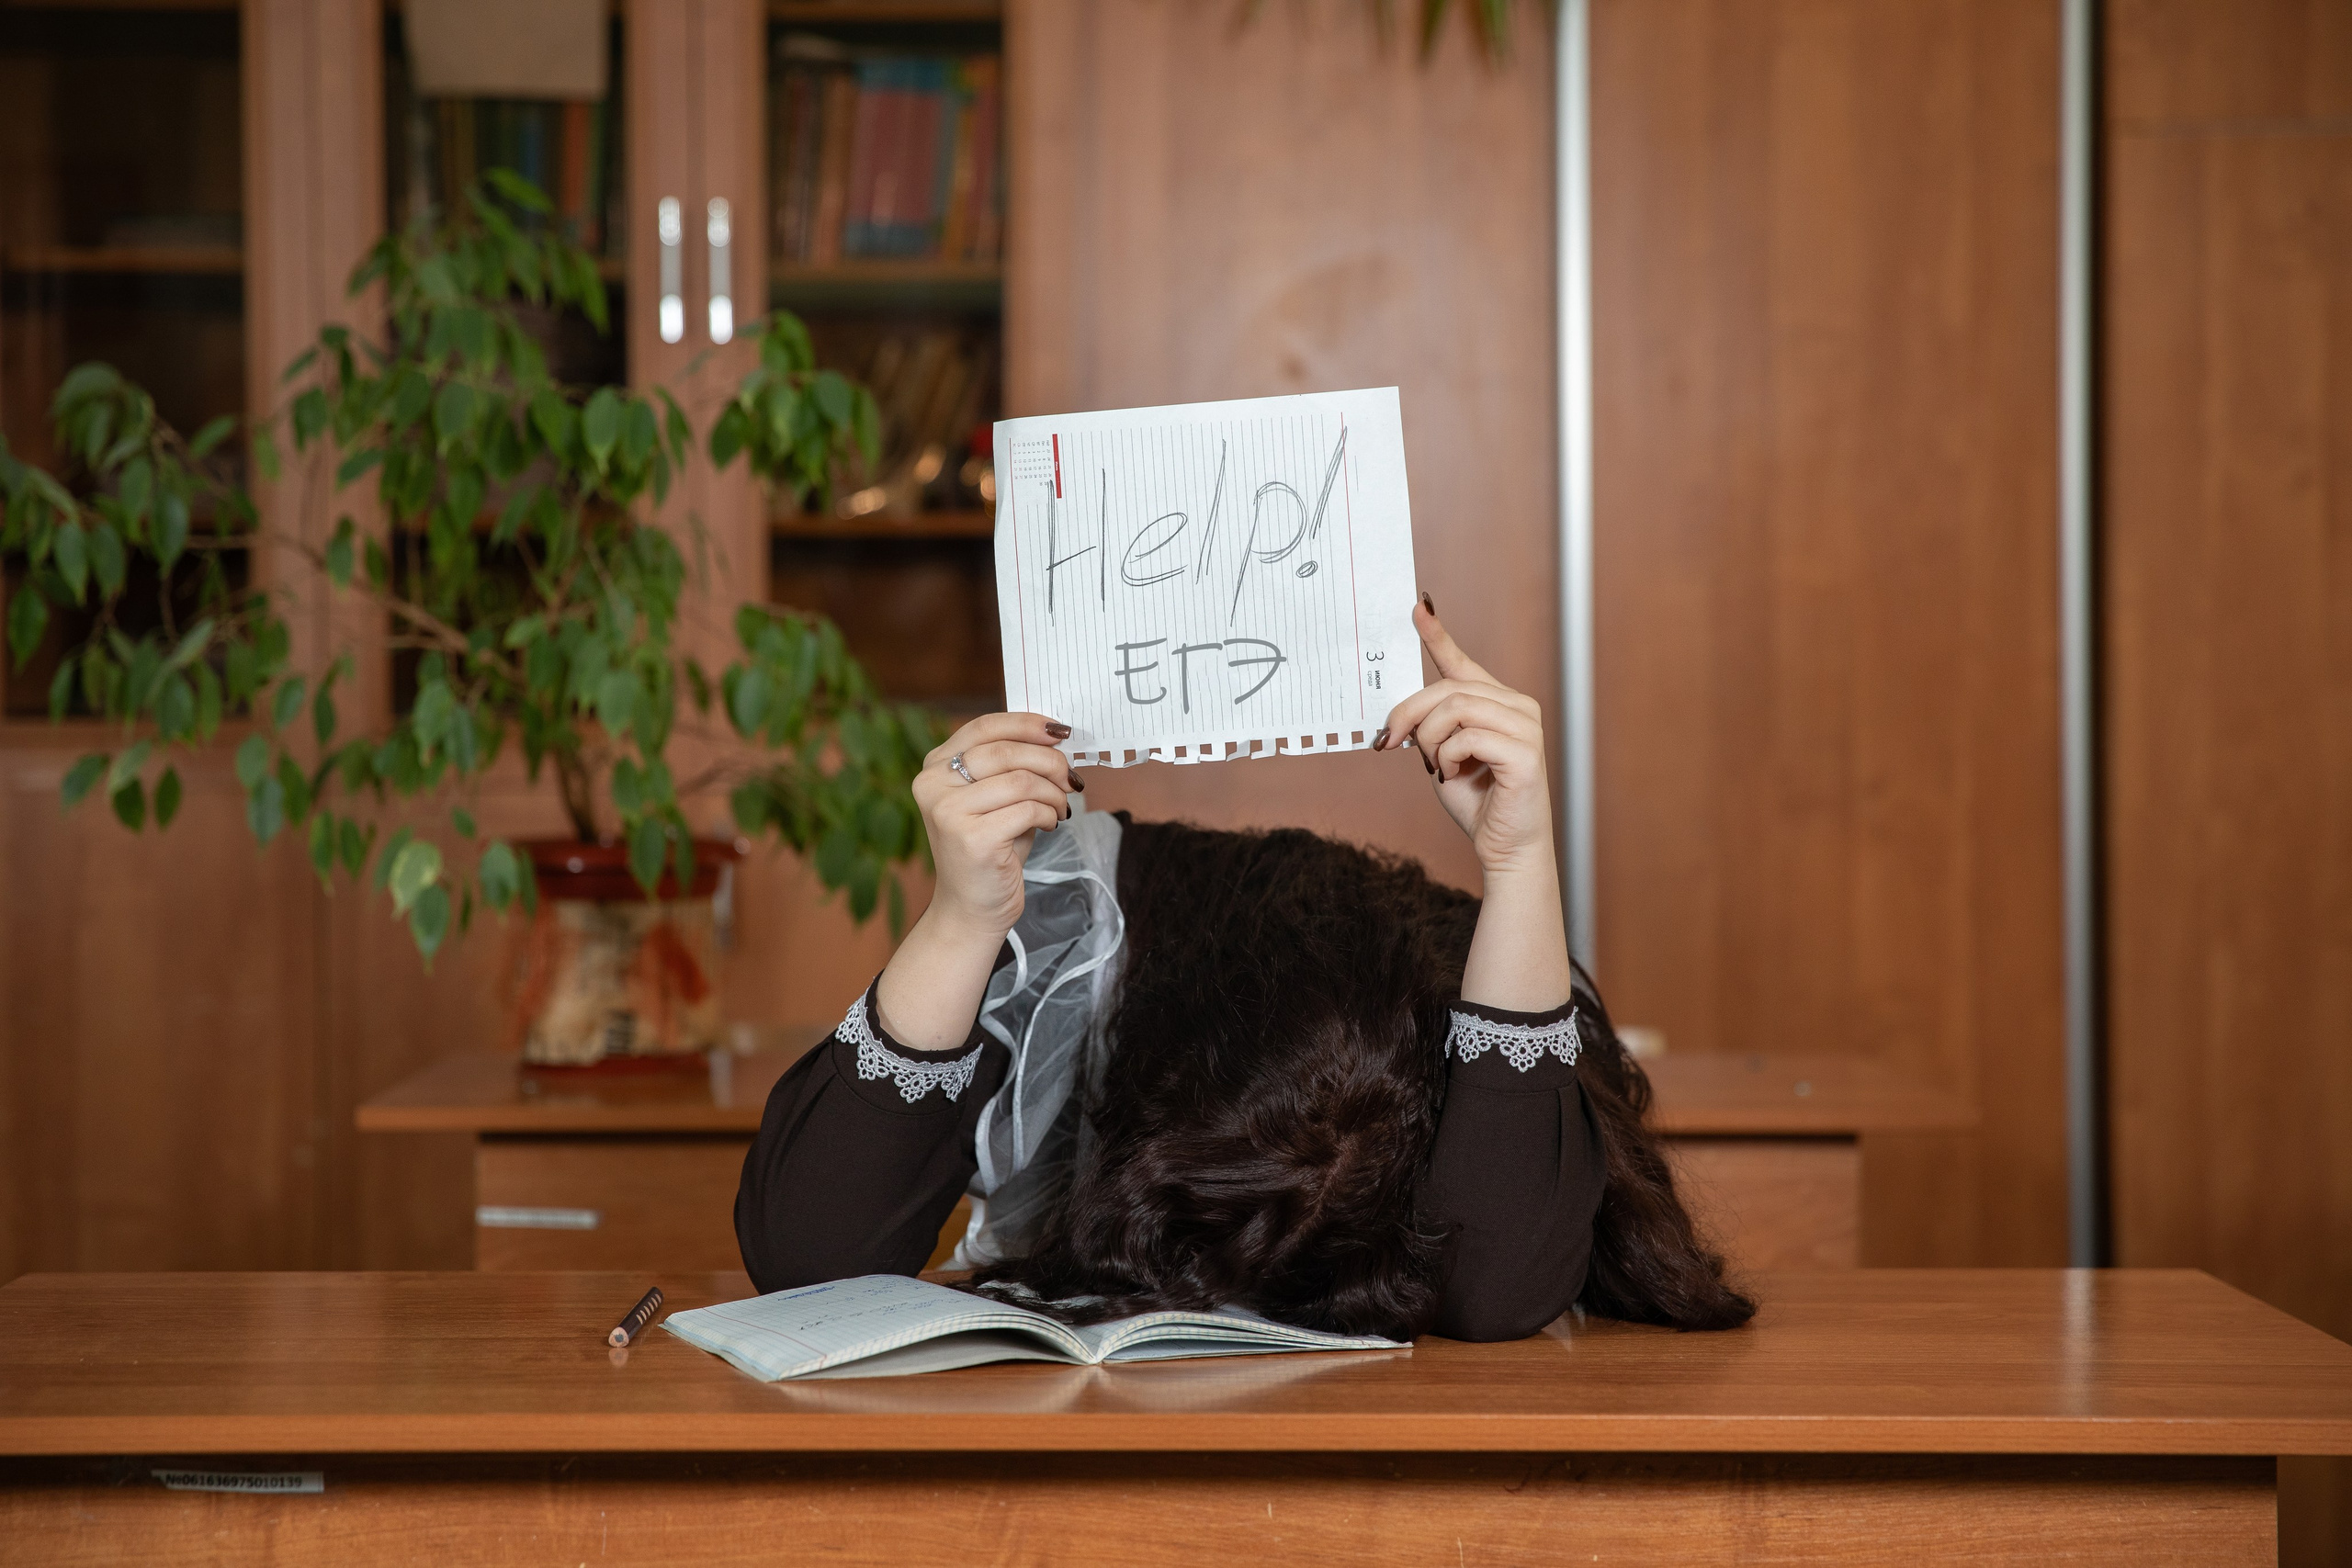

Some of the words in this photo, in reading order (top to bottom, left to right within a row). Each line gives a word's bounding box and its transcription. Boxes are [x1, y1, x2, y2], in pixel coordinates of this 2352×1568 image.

[1046, 425, 1347, 626] Help!
[1114, 637, 1286, 715] ЕГЭ
[1366, 651, 1385, 661] 3
